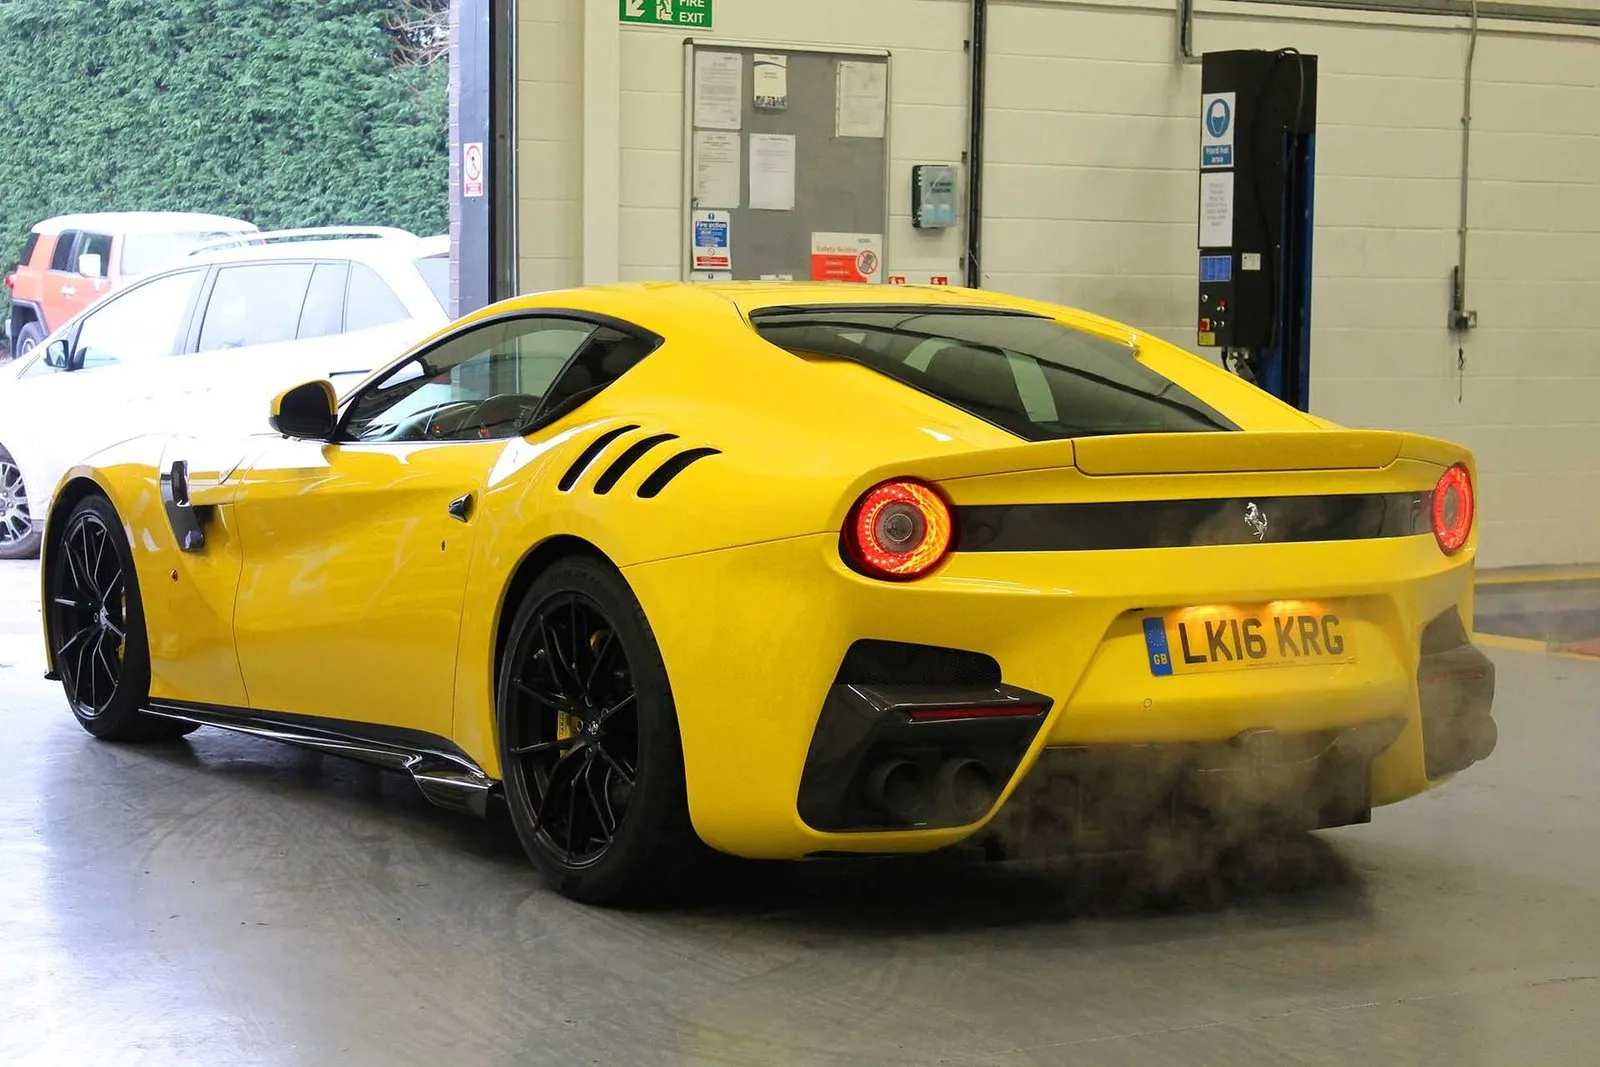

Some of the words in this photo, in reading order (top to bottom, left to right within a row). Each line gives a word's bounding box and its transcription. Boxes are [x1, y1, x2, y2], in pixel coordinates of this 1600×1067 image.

[679, 12, 705, 23] EXIT
[1178, 618, 1267, 664] LK16
[1273, 614, 1344, 657] KRG
[1153, 653, 1168, 665] GB
